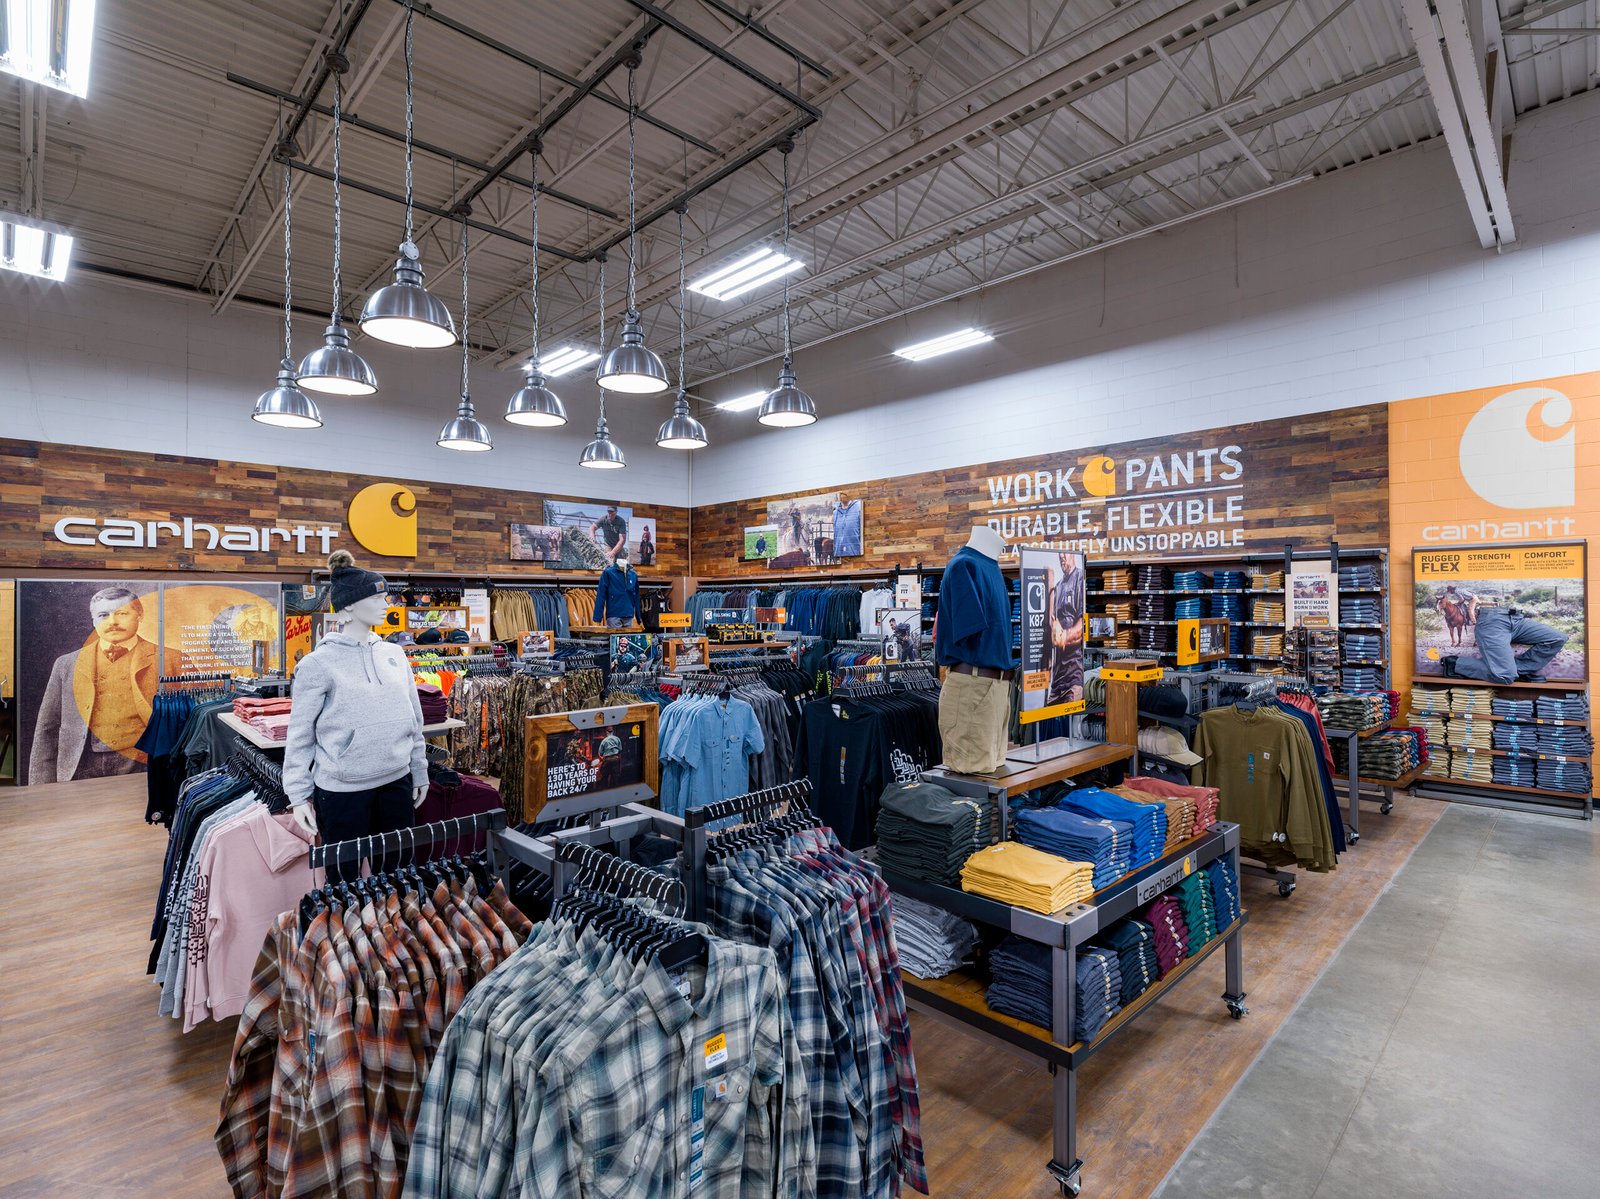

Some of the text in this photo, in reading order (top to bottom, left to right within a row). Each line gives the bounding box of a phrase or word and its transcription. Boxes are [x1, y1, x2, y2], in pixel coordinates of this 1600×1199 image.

[988, 446, 1244, 505] WORK PANTS
[1108, 495, 1244, 531] FLEXIBLE
[54, 517, 339, 554] carhartt
[1422, 516, 1576, 541] carhartt
[1111, 529, 1245, 552] UNSTOPPABLE
[1421, 554, 1460, 562] RUGGED
[1524, 551, 1567, 559] COMFORT
[1421, 562, 1460, 573] FLEX
[1029, 614, 1045, 627] K87
[548, 764, 576, 775] HERE'S
[548, 768, 599, 782] 130 YEARS OF
[548, 775, 596, 791] HAVING YOUR
[548, 784, 588, 798] BACK 24/7
[1143, 867, 1183, 901] carhartt
